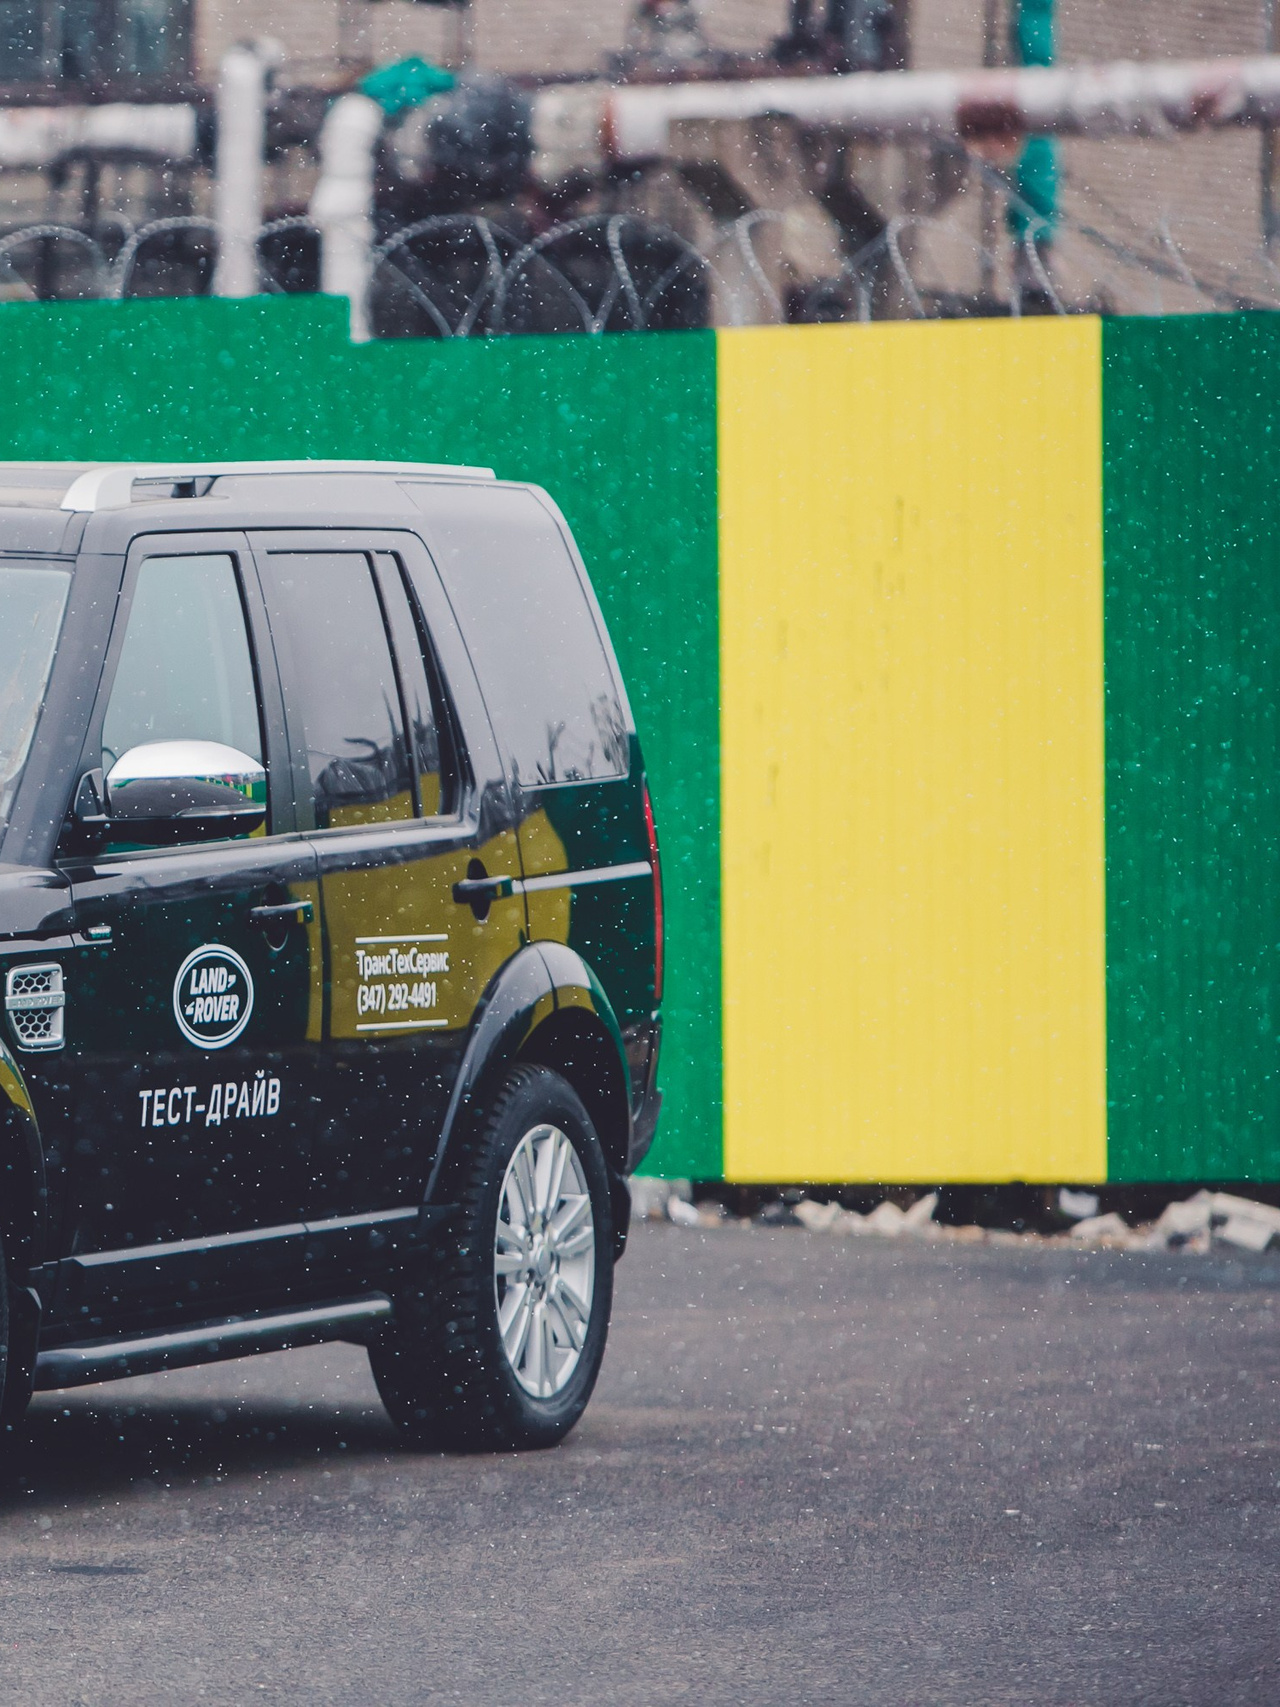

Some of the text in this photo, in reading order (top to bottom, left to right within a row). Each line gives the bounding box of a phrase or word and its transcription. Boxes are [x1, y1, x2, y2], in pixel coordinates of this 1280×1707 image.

[189, 966, 229, 994] LAND
[355, 946, 450, 981] ТрансТехСервис
[193, 993, 240, 1024] ROVER
[357, 981, 437, 1016] (347) 292-4491
[138, 1069, 282, 1128] ТЕСТ-ДРАЙВ
